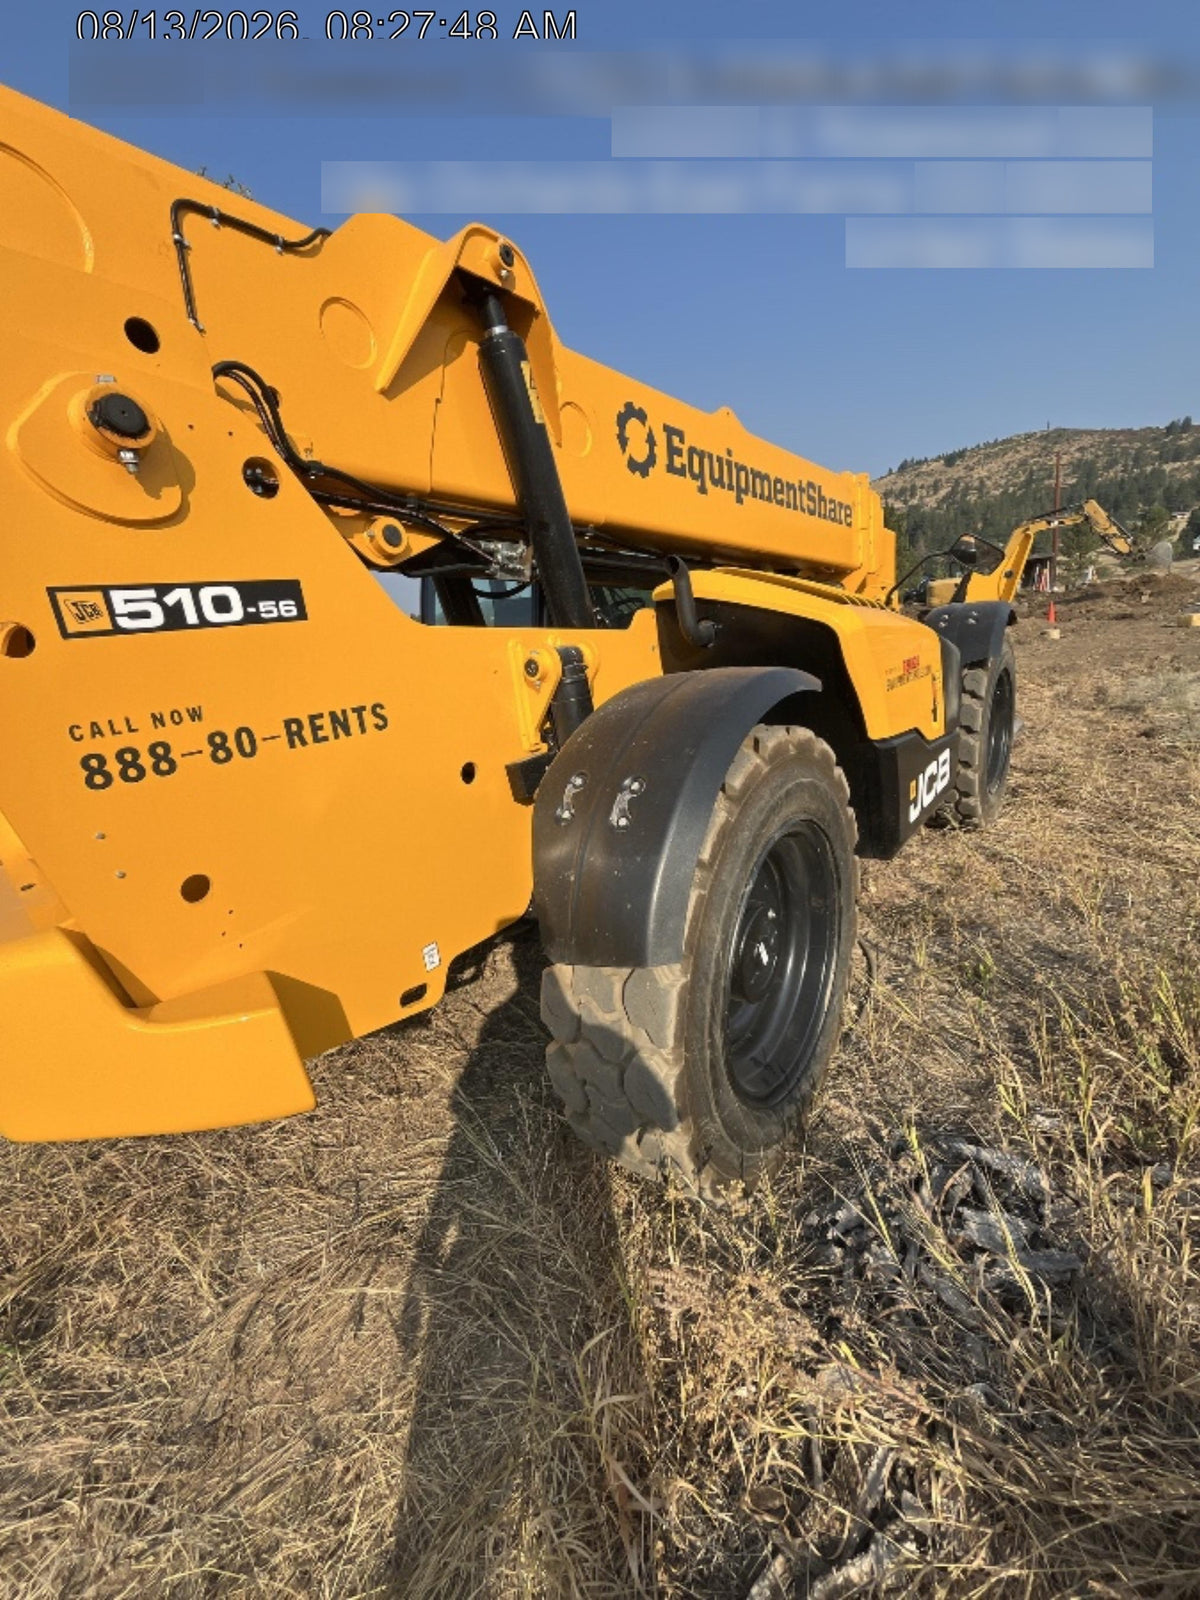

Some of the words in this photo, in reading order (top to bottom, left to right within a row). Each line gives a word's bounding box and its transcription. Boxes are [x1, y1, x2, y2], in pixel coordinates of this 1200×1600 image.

[662, 422, 853, 528] EquipmentShare
[68, 715, 140, 743] CALL
[150, 705, 204, 730] NOW
[79, 702, 390, 791] 888-80-RENTS
[909, 747, 951, 824] JCB
